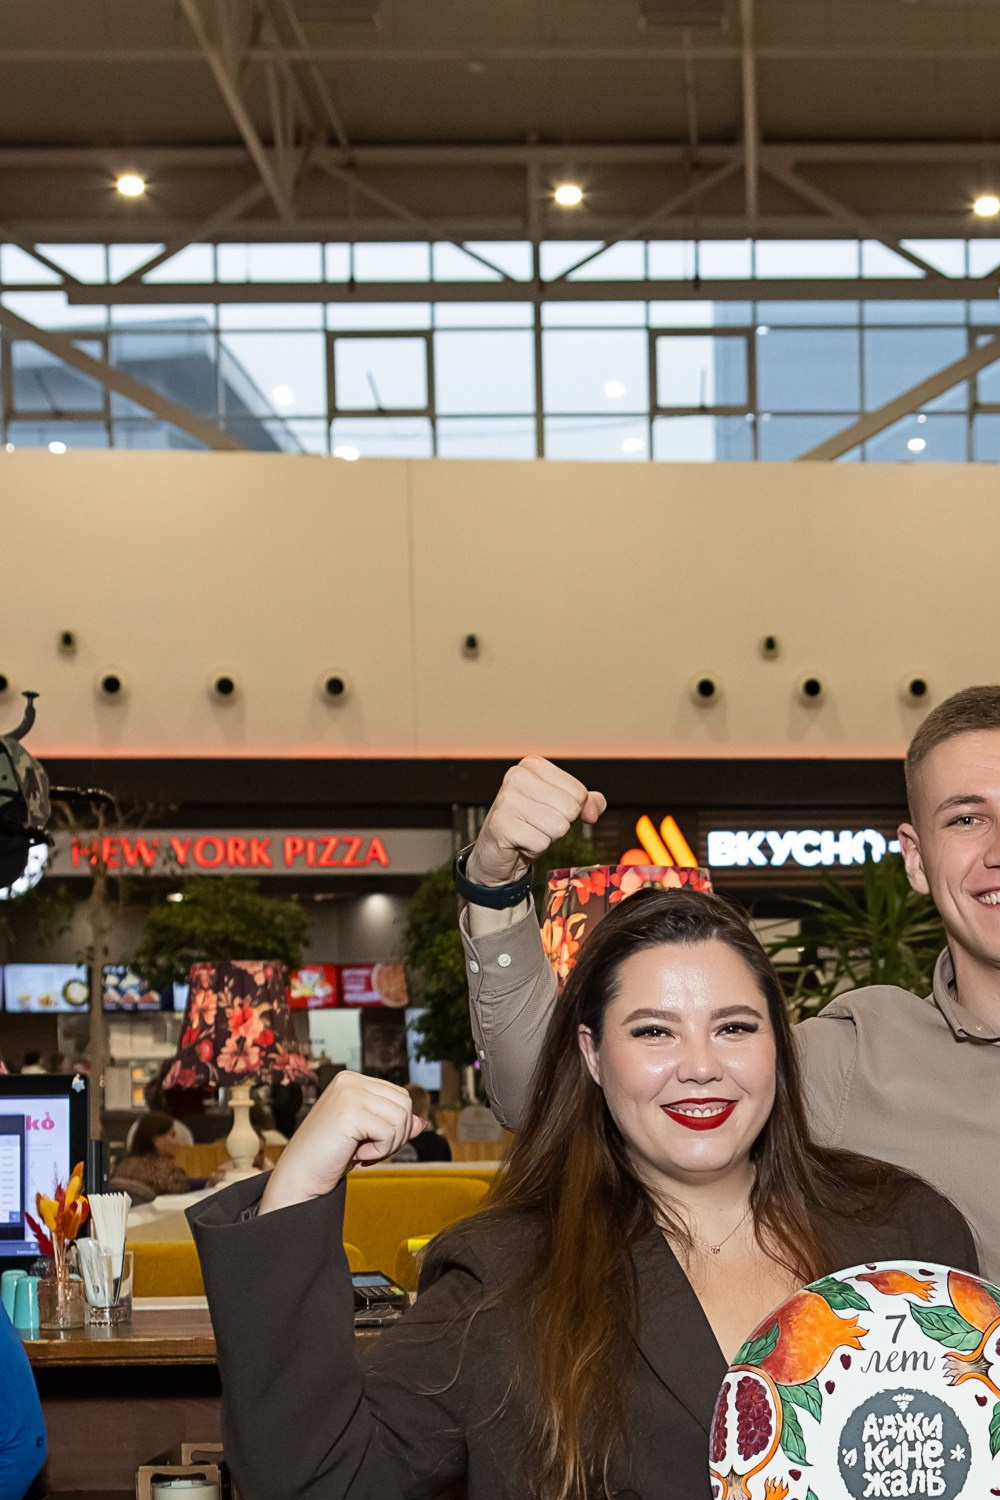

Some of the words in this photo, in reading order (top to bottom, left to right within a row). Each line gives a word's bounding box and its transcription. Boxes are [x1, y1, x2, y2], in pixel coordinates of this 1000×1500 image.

[170, 836, 273, 867] YORK
[283, 836, 390, 867] PIZZA
[885, 1314, 907, 1344] 7
[860, 1350, 936, 1373] лет
